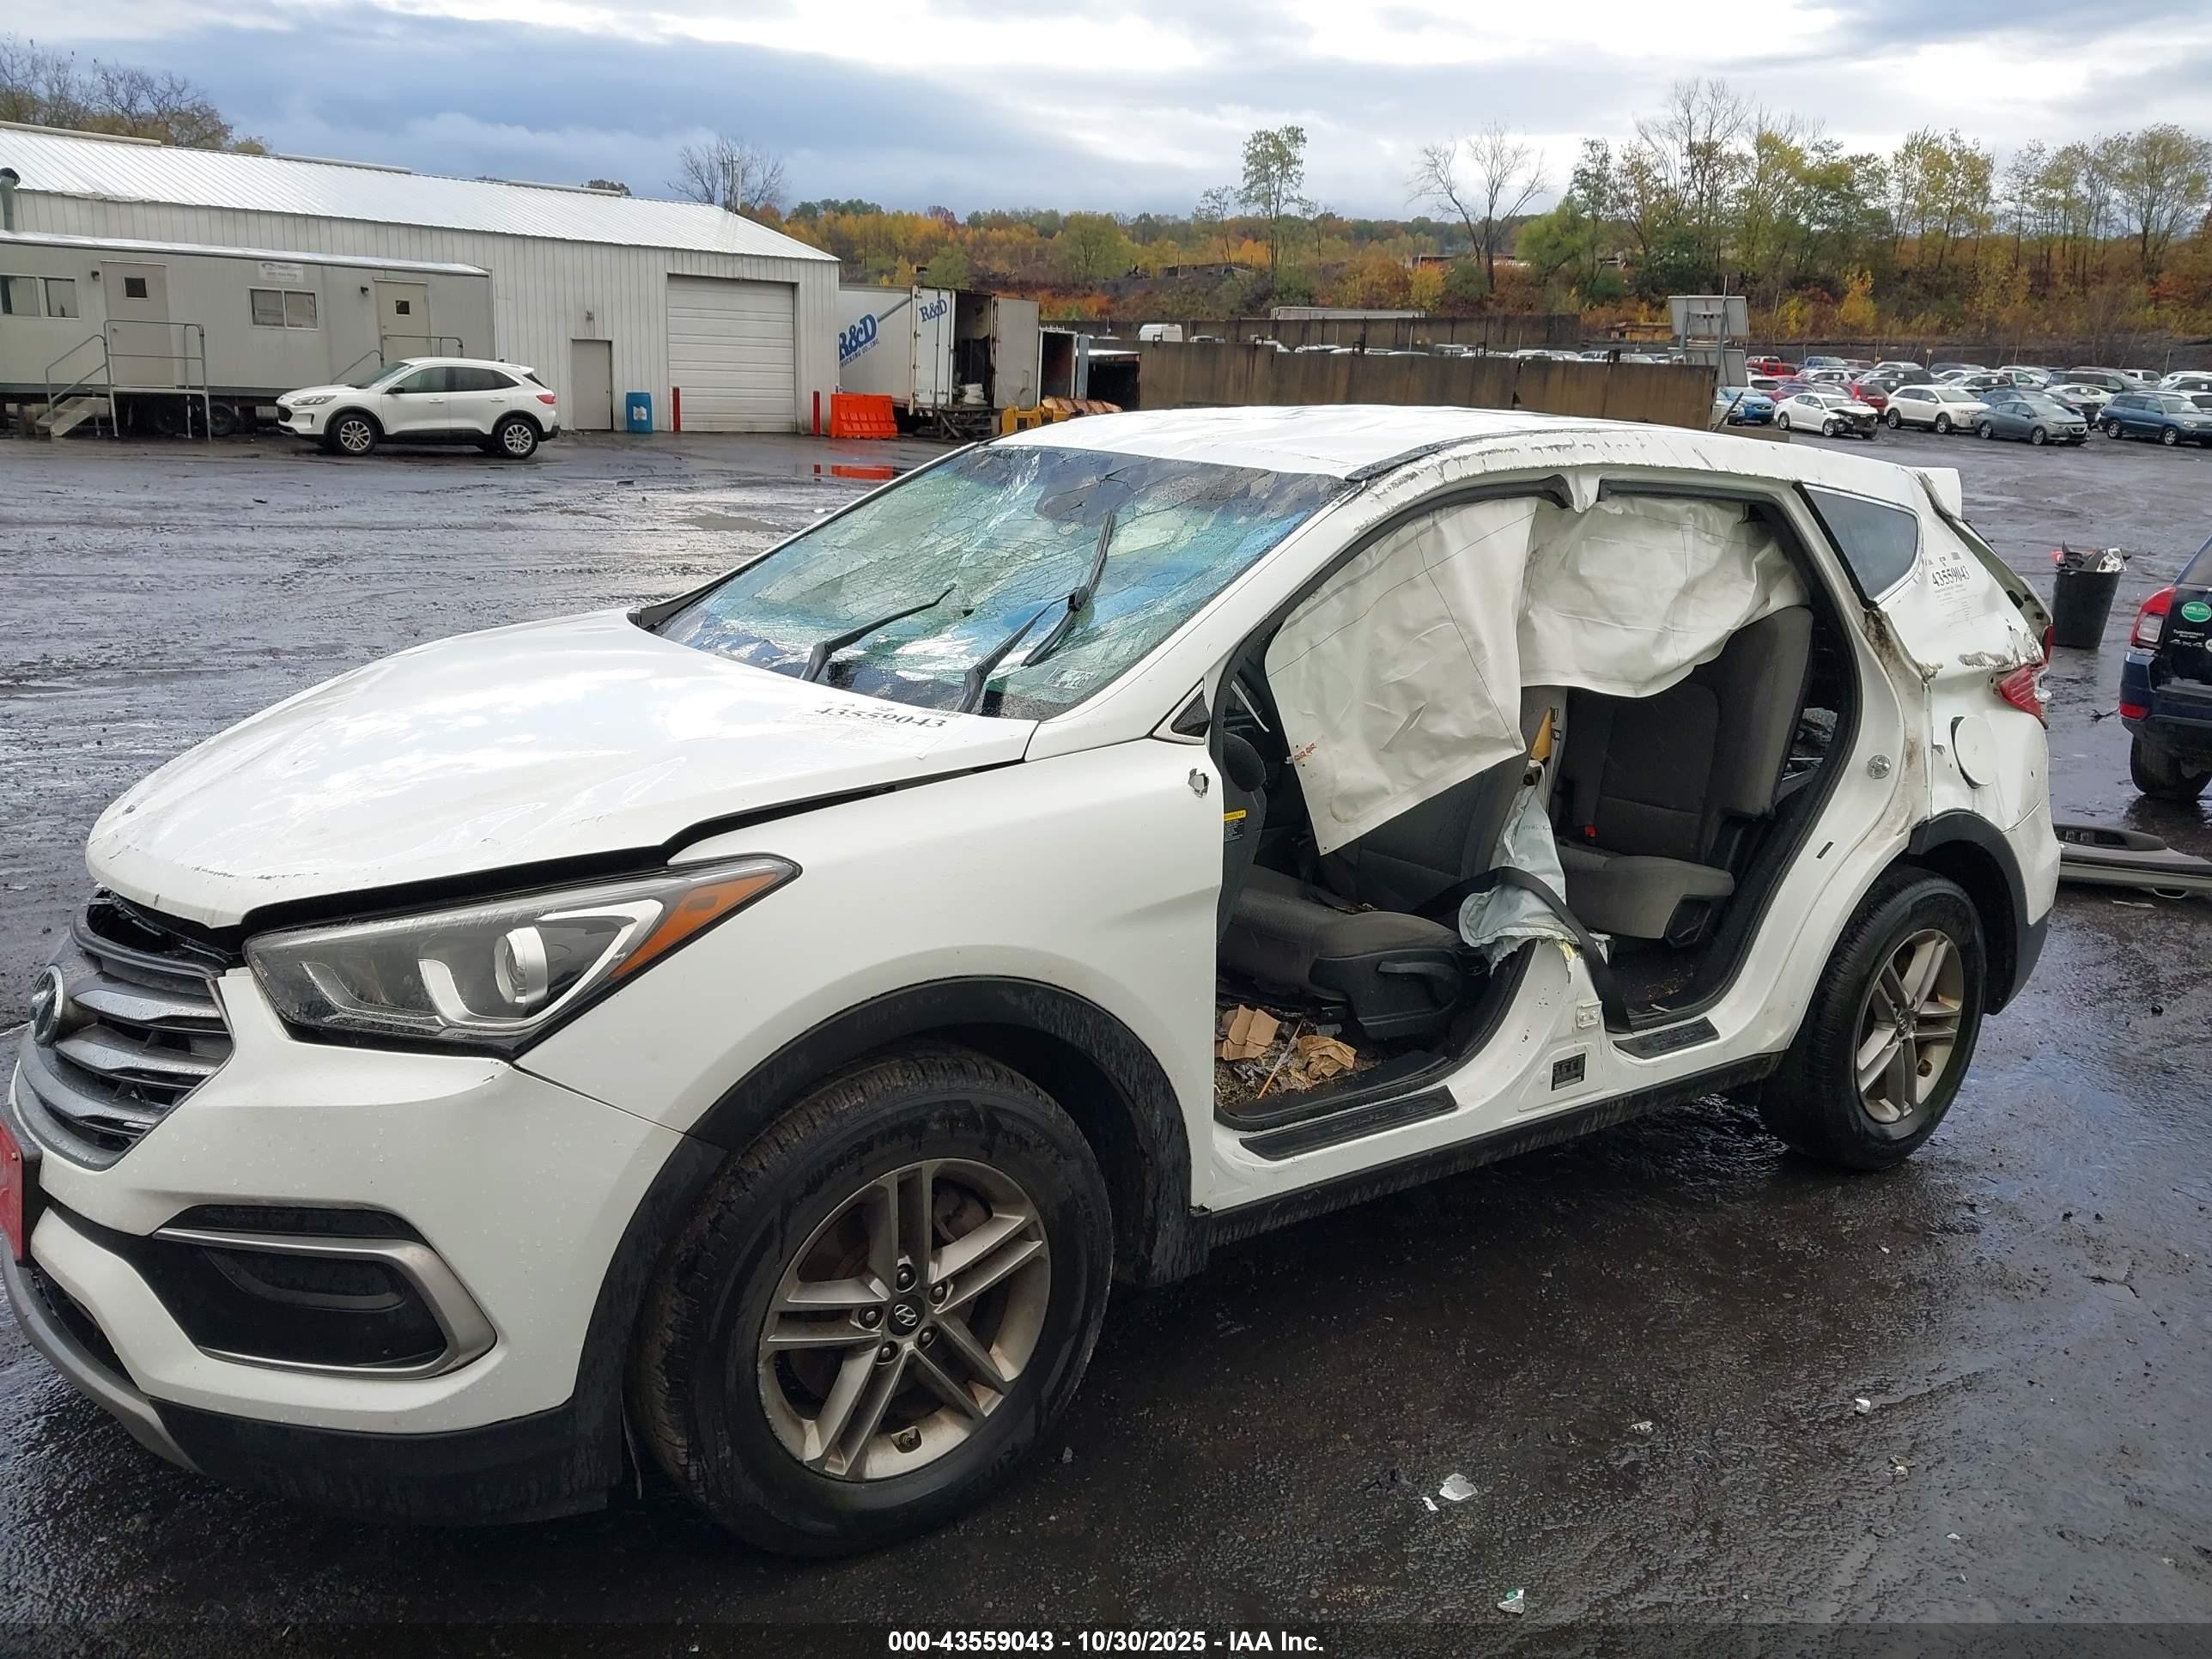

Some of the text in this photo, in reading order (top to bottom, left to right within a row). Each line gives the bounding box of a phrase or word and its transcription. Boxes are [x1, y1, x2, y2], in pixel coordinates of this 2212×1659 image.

[919, 299, 948, 323] R&D
[839, 314, 877, 362] R&D
[1932, 565, 1971, 586] 43559043
[814, 708, 947, 727] 43559043
